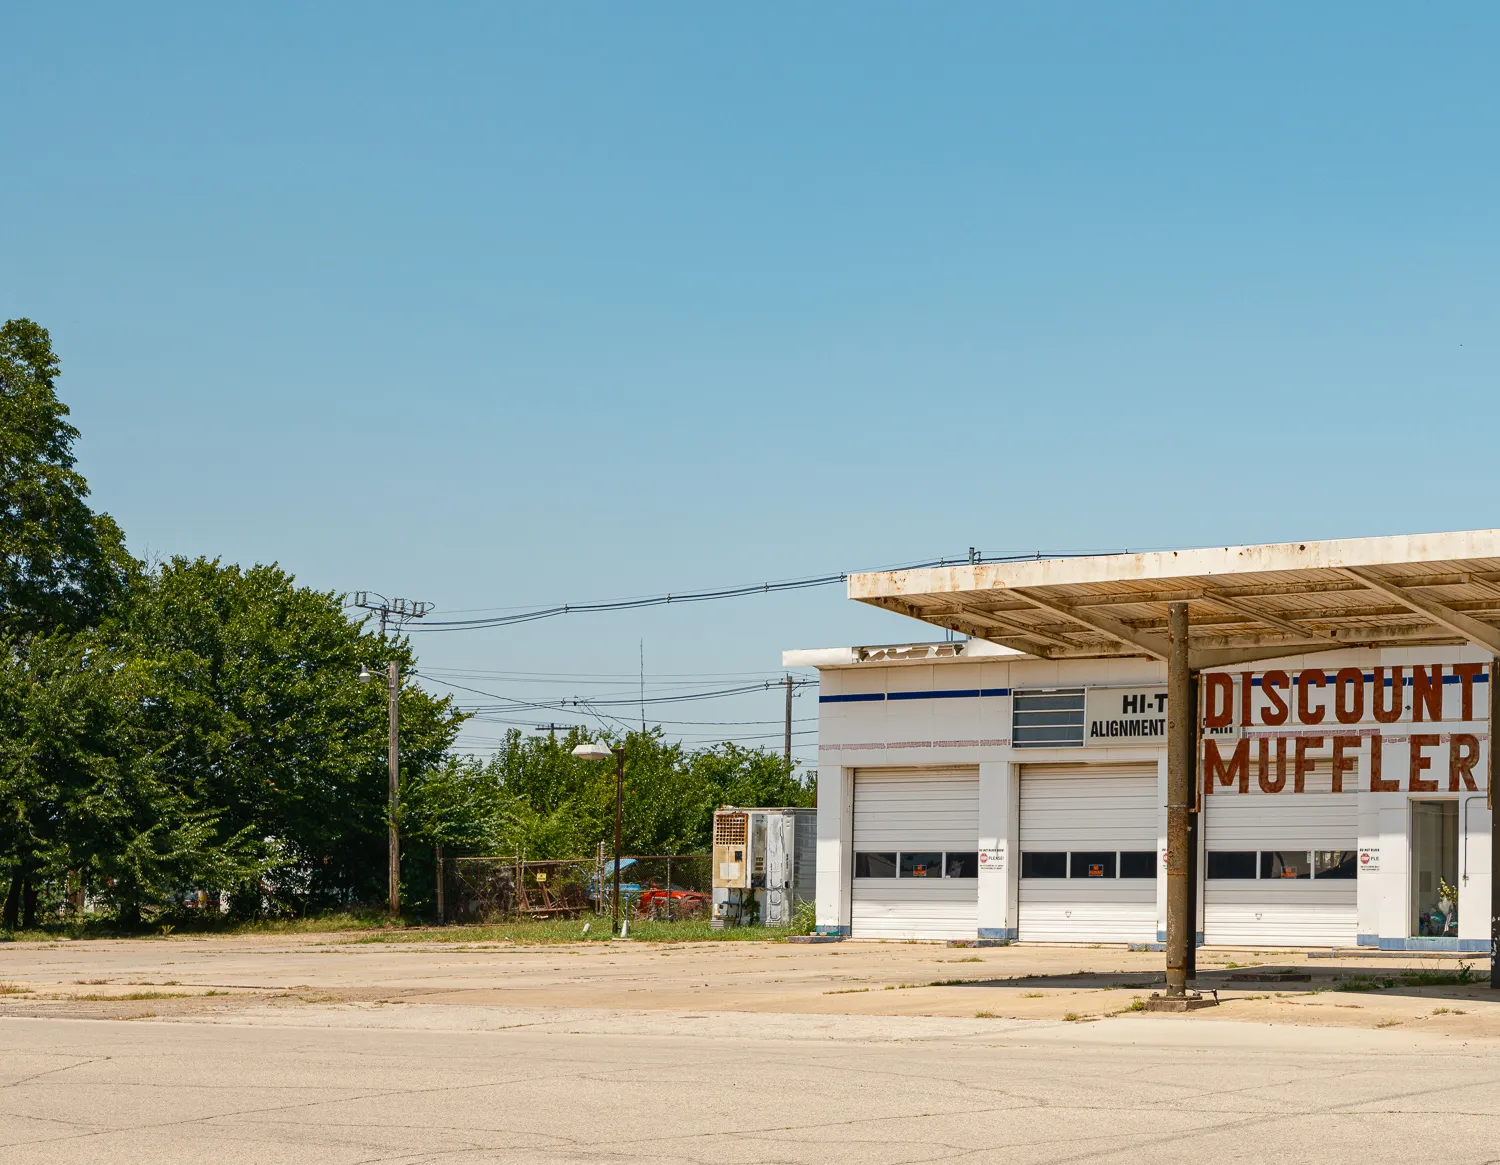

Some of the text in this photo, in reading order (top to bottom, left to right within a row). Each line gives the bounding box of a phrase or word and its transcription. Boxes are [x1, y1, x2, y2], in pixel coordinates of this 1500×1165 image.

[1205, 663, 1483, 727] DISCOUNT
[1090, 719, 1166, 737] ALIGNMENT
[1203, 733, 1480, 794] MUFFLER
